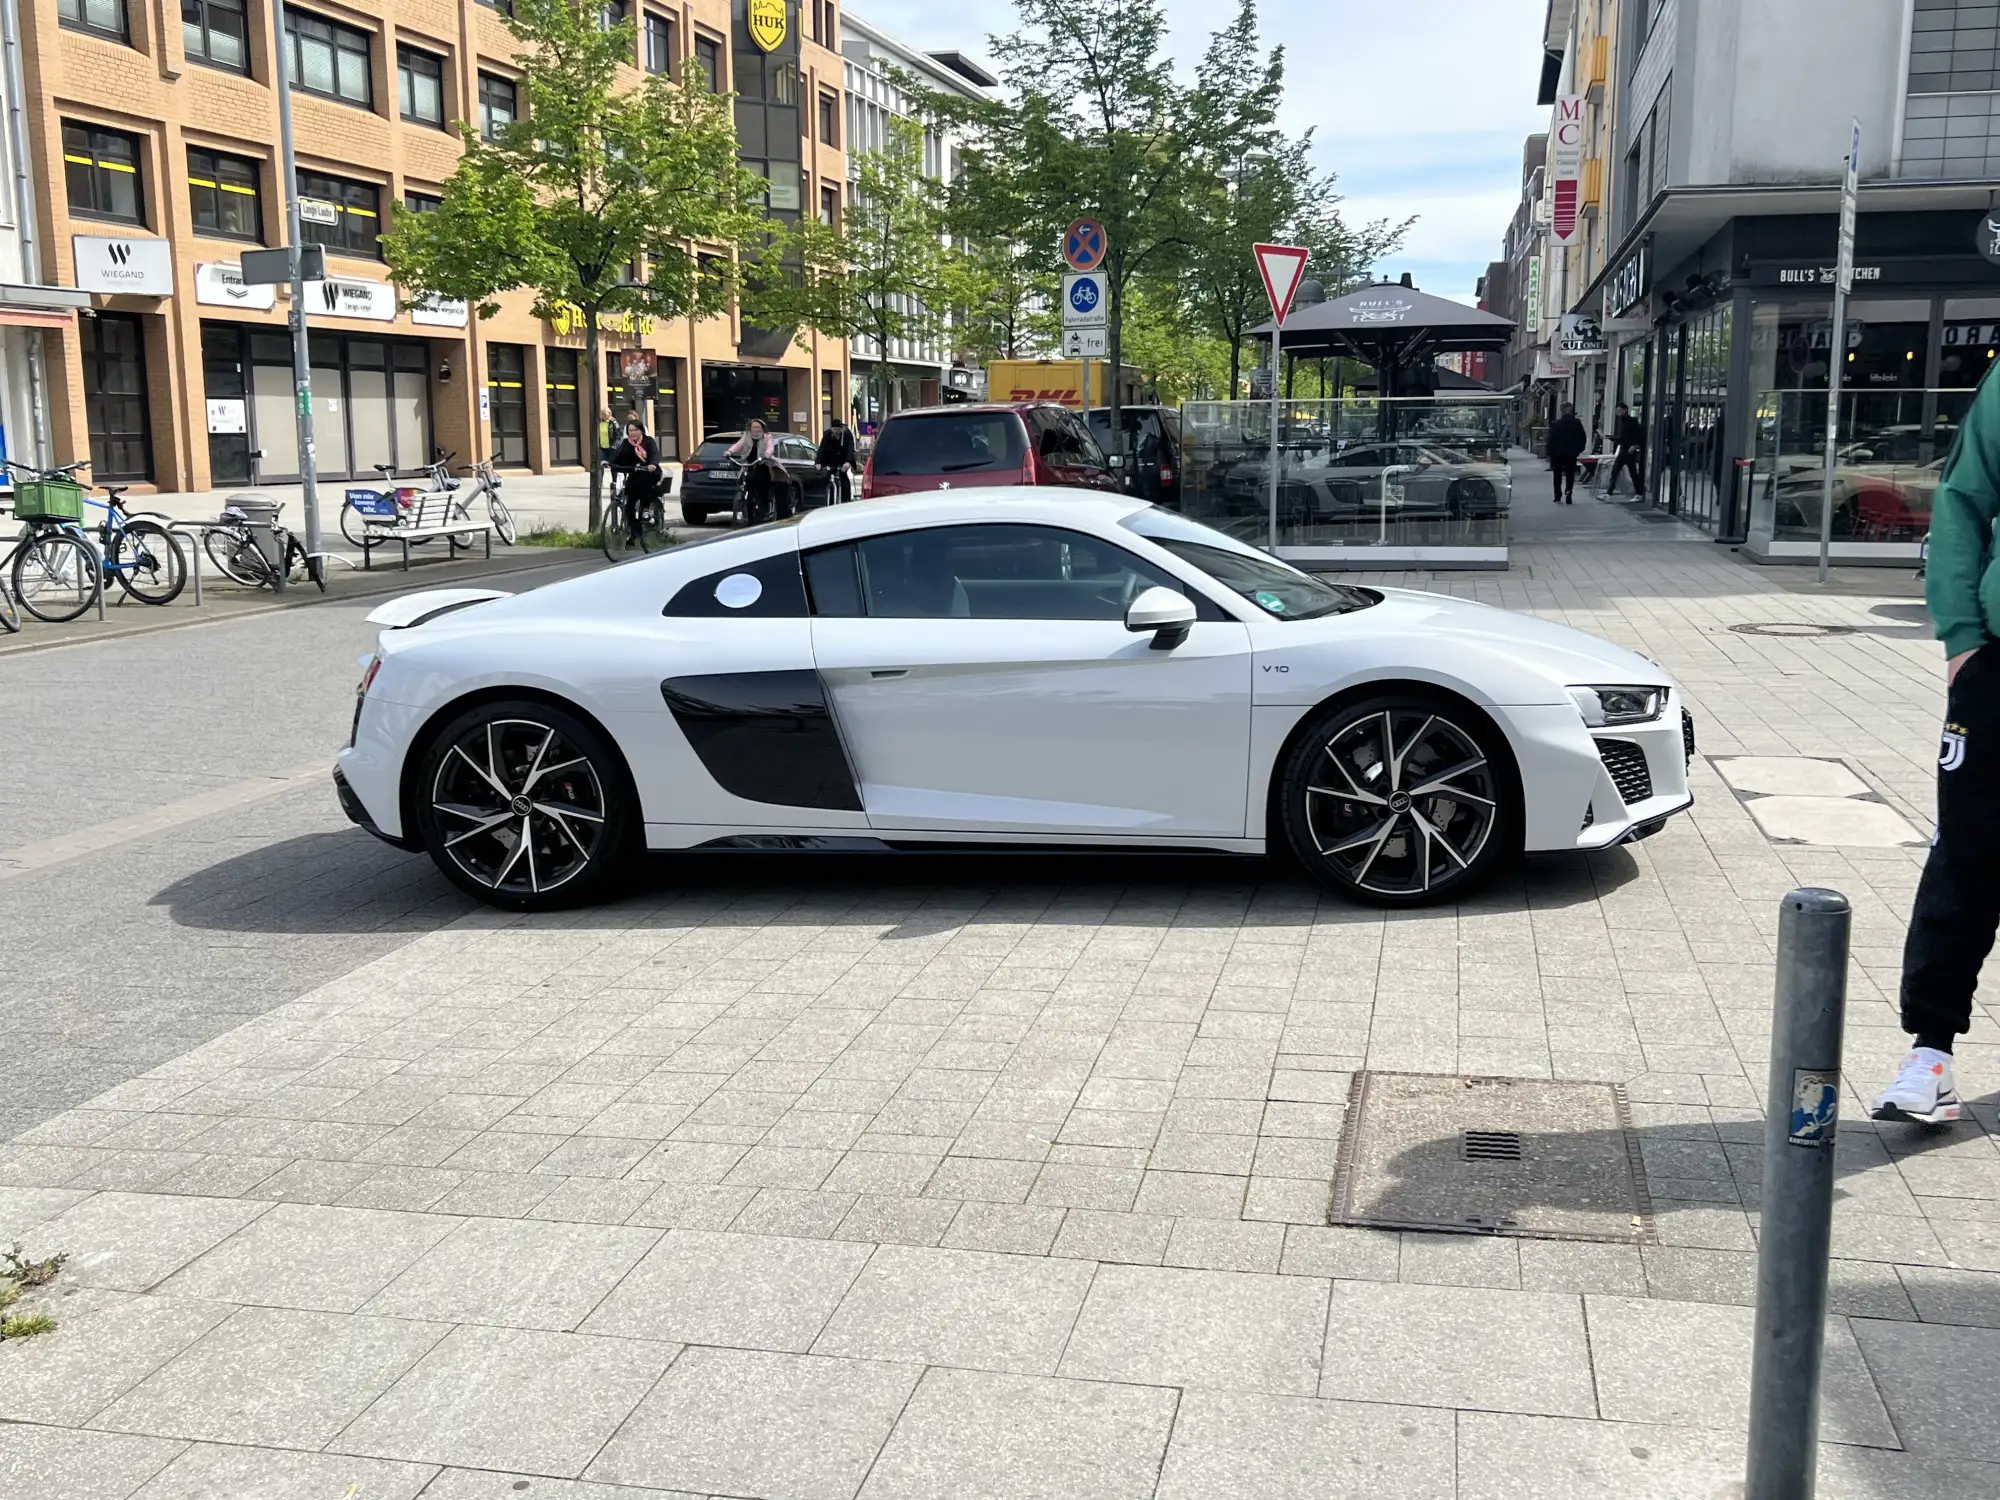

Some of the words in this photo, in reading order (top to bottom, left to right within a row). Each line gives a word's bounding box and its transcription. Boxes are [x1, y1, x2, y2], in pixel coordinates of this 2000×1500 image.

[753, 14, 785, 30] HUK
[101, 269, 144, 279] WIEGAND
[1780, 269, 1815, 282] BULL'S
[1850, 267, 1880, 280] TCHEN
[342, 288, 373, 301] WIEGAND
[1065, 315, 1105, 323] Fahrradstraße
[1563, 331, 1576, 340] AL
[1087, 337, 1103, 348] frei
[1009, 390, 1081, 405] DHL
[363, 505, 376, 513] nix.
